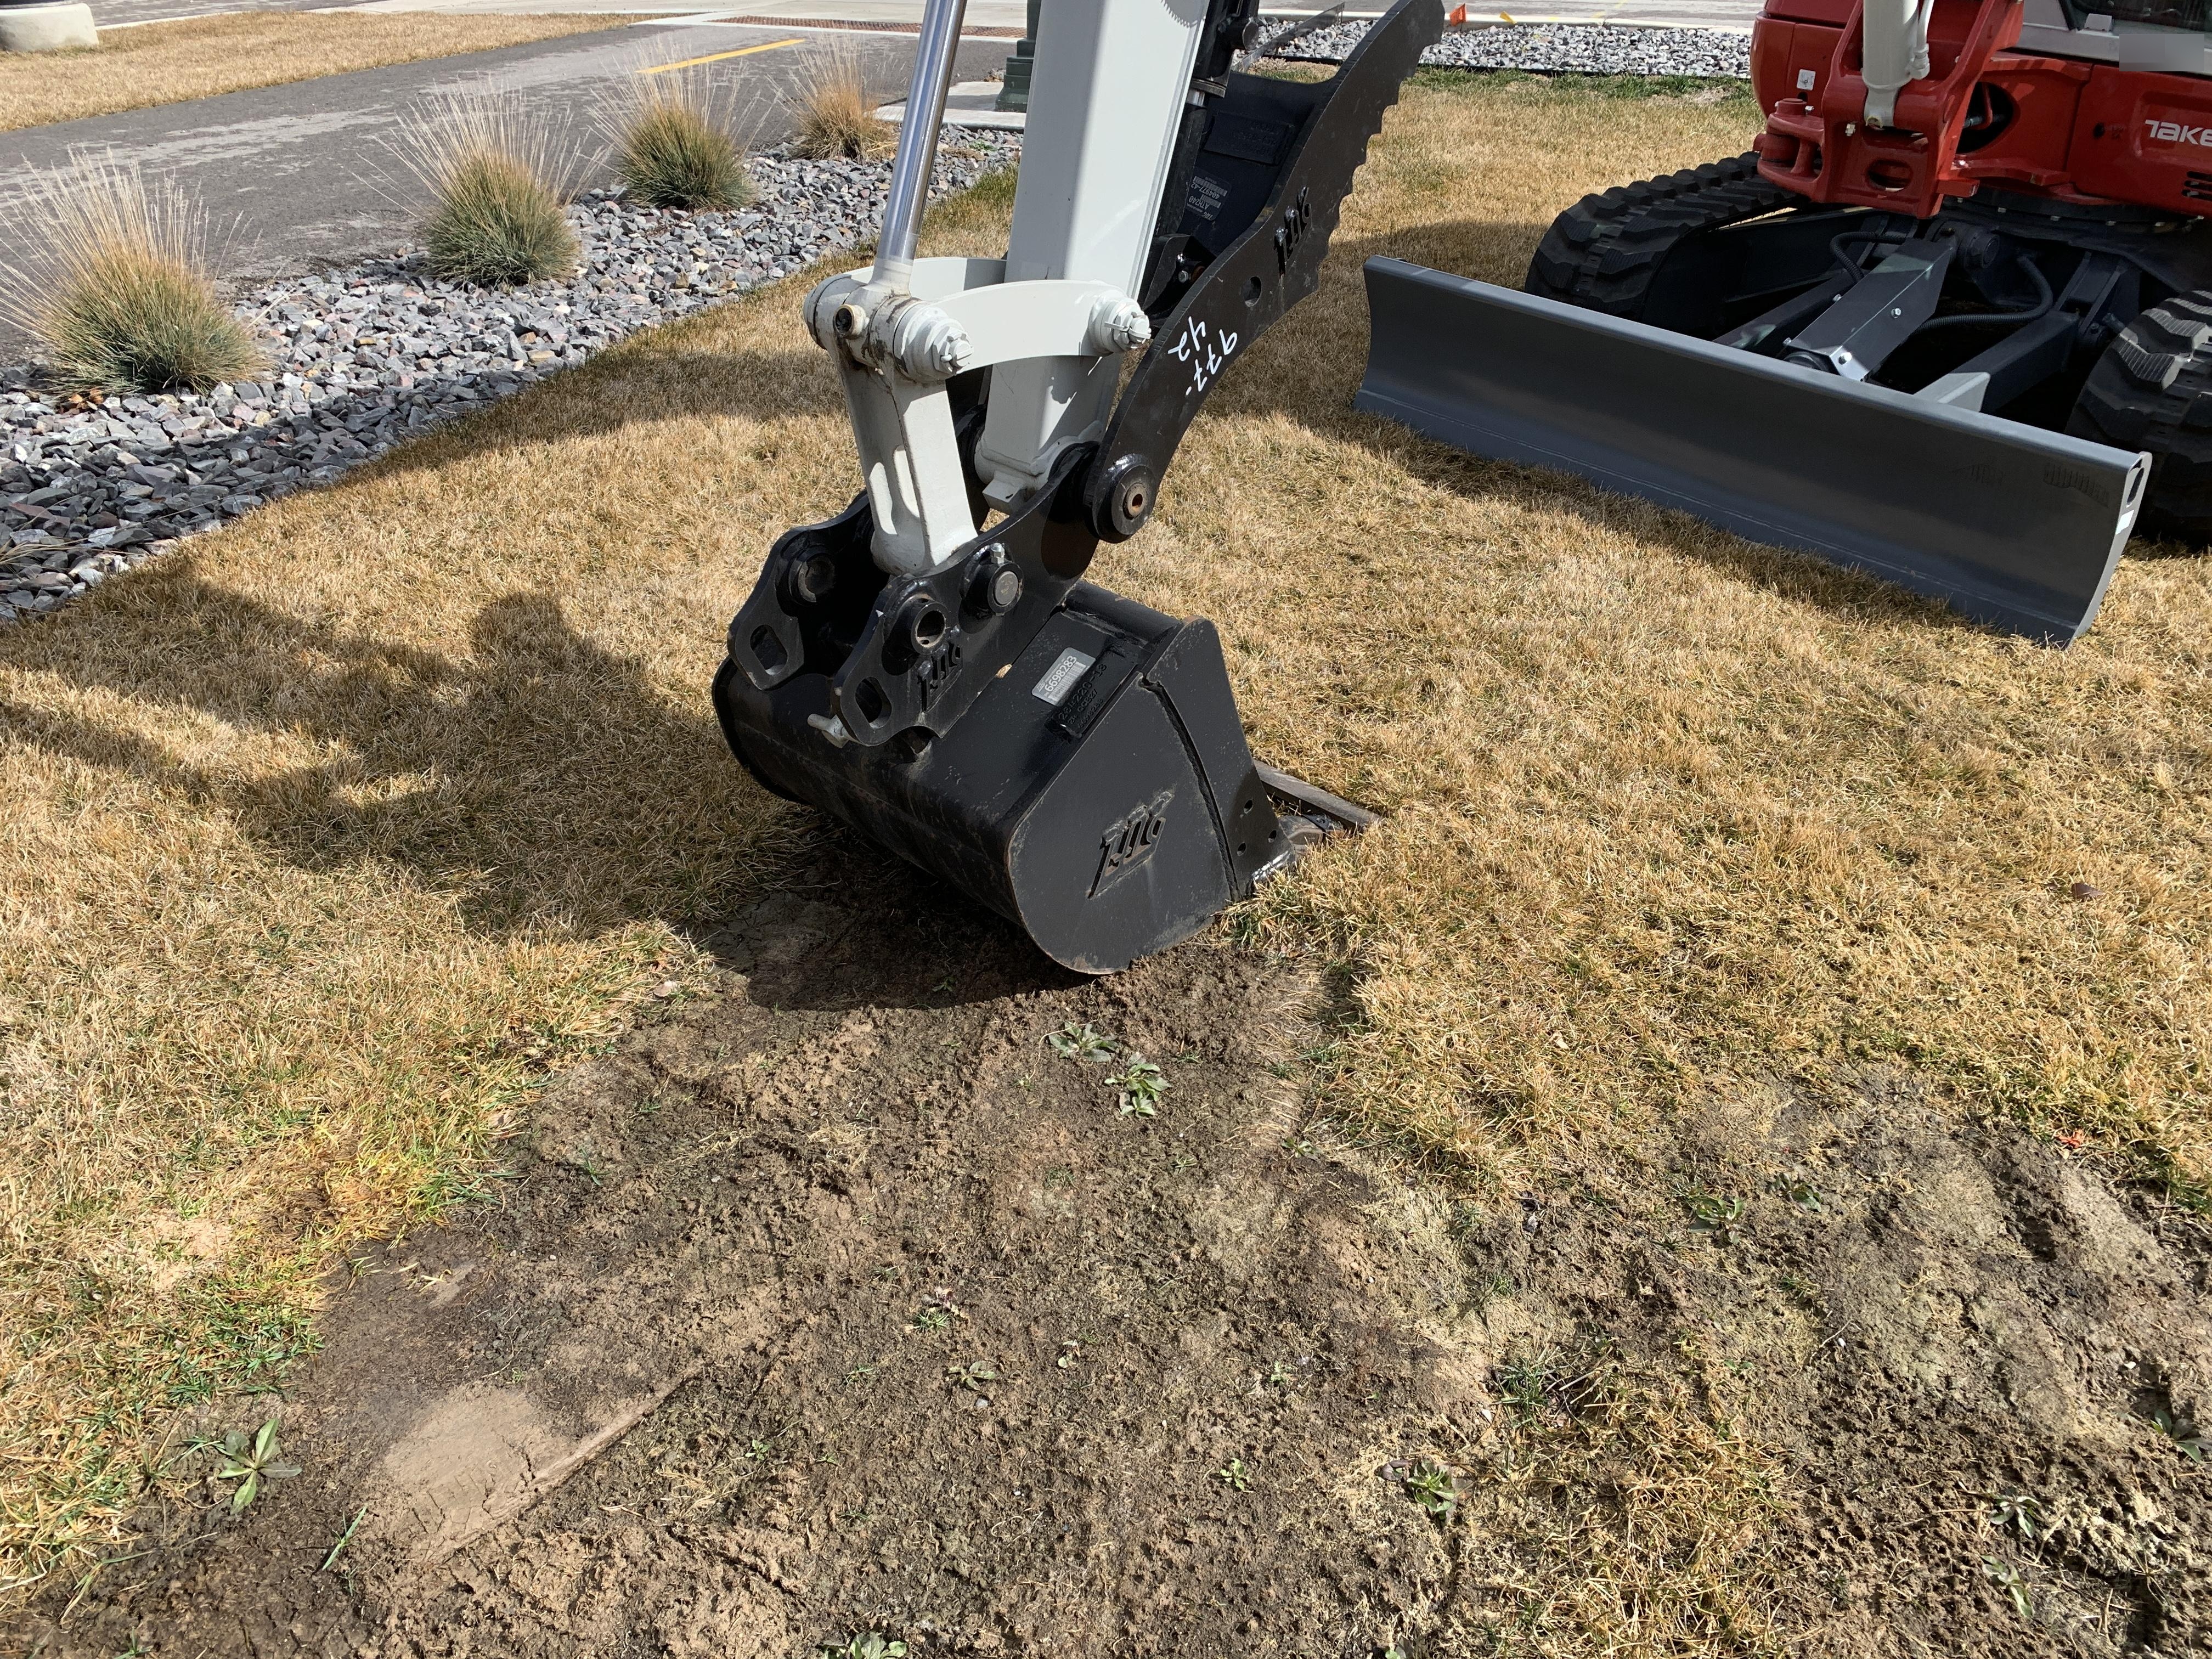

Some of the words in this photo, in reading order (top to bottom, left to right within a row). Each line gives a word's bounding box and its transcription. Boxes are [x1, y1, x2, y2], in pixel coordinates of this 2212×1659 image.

[1188, 195, 1210, 210] ATH240
[1167, 316, 1206, 362] 42
[1045, 656, 1077, 692] 6698283
